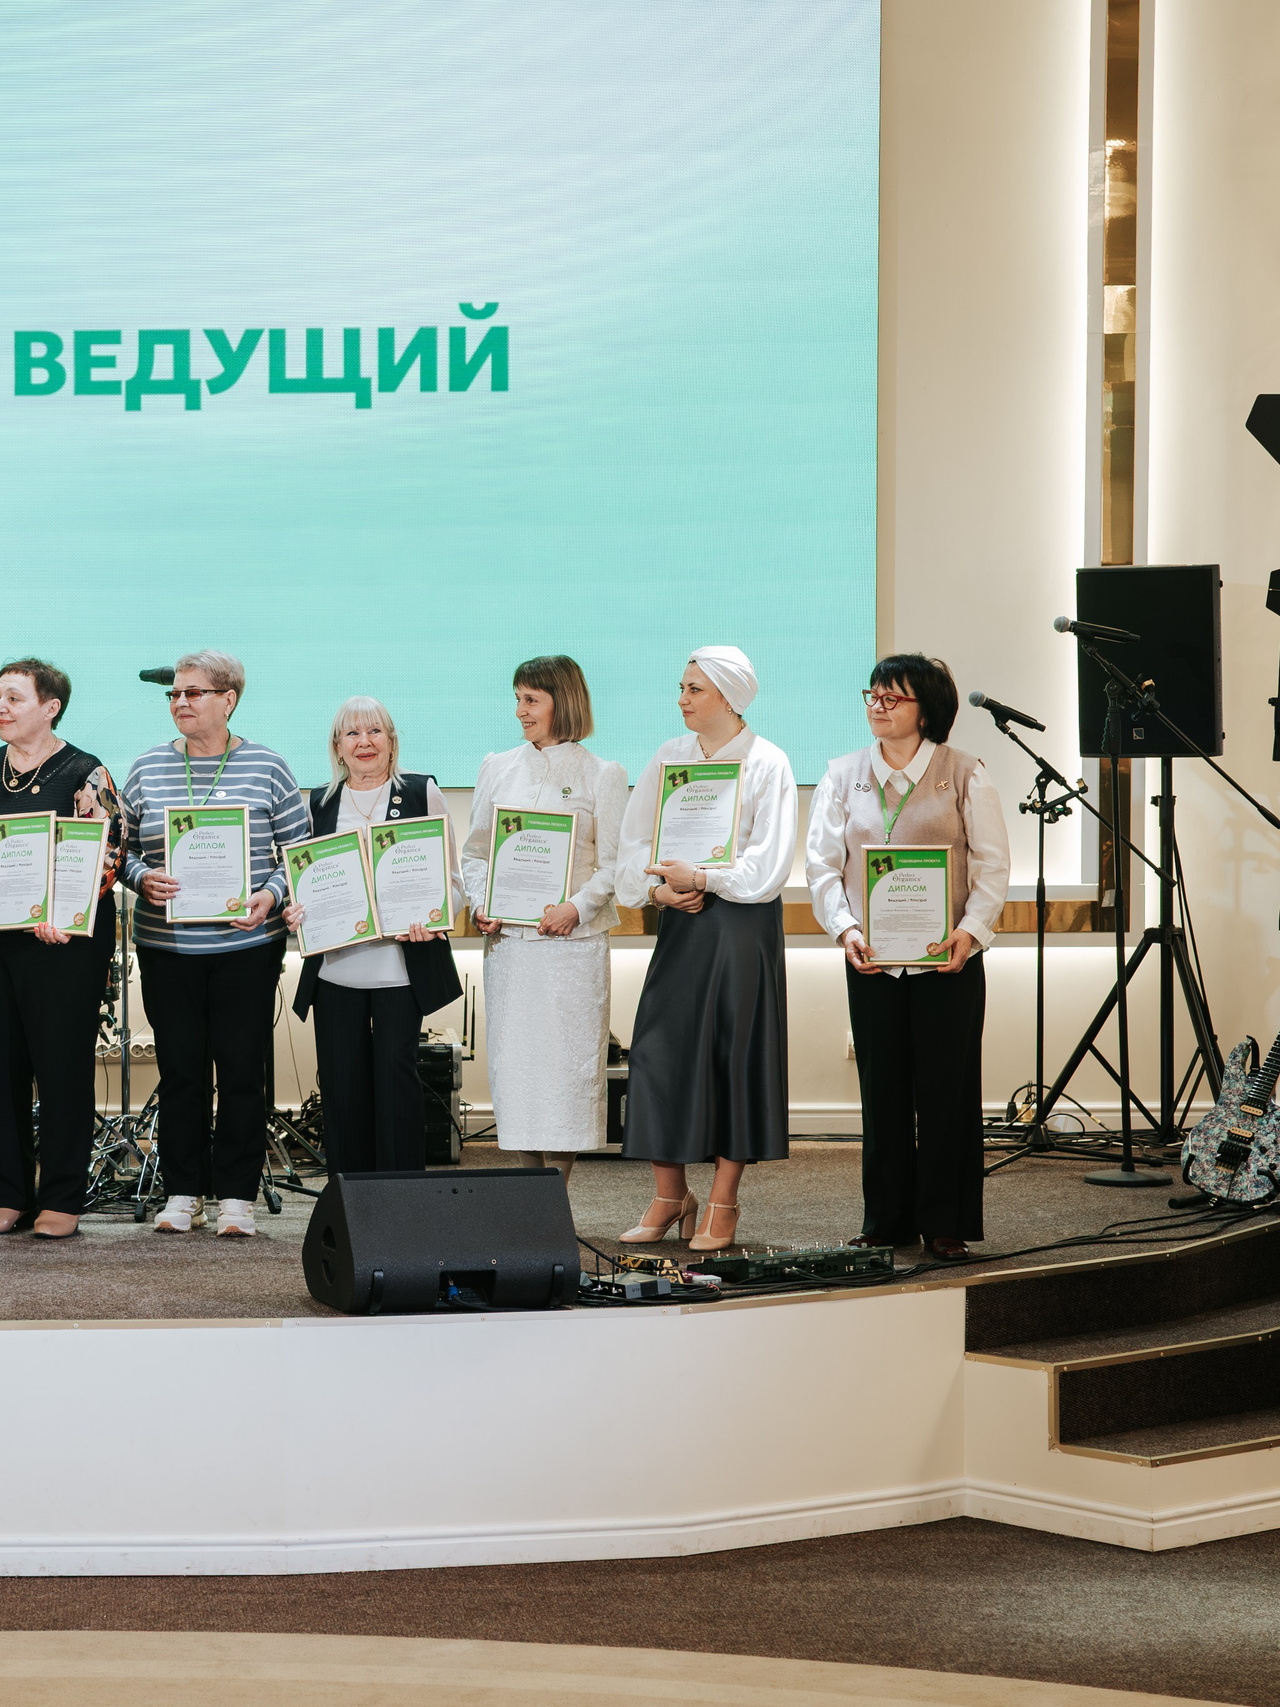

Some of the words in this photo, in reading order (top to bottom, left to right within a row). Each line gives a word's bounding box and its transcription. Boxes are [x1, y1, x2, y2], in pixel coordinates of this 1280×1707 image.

[14, 302, 509, 411] ВЕДУЩИЙ
[1, 850, 32, 859] ДИПЛОМ
[514, 845, 551, 854] ДИПЛОМ
[392, 855, 427, 865] ДИПЛОМ
[311, 870, 346, 884] ДИПЛОМ
